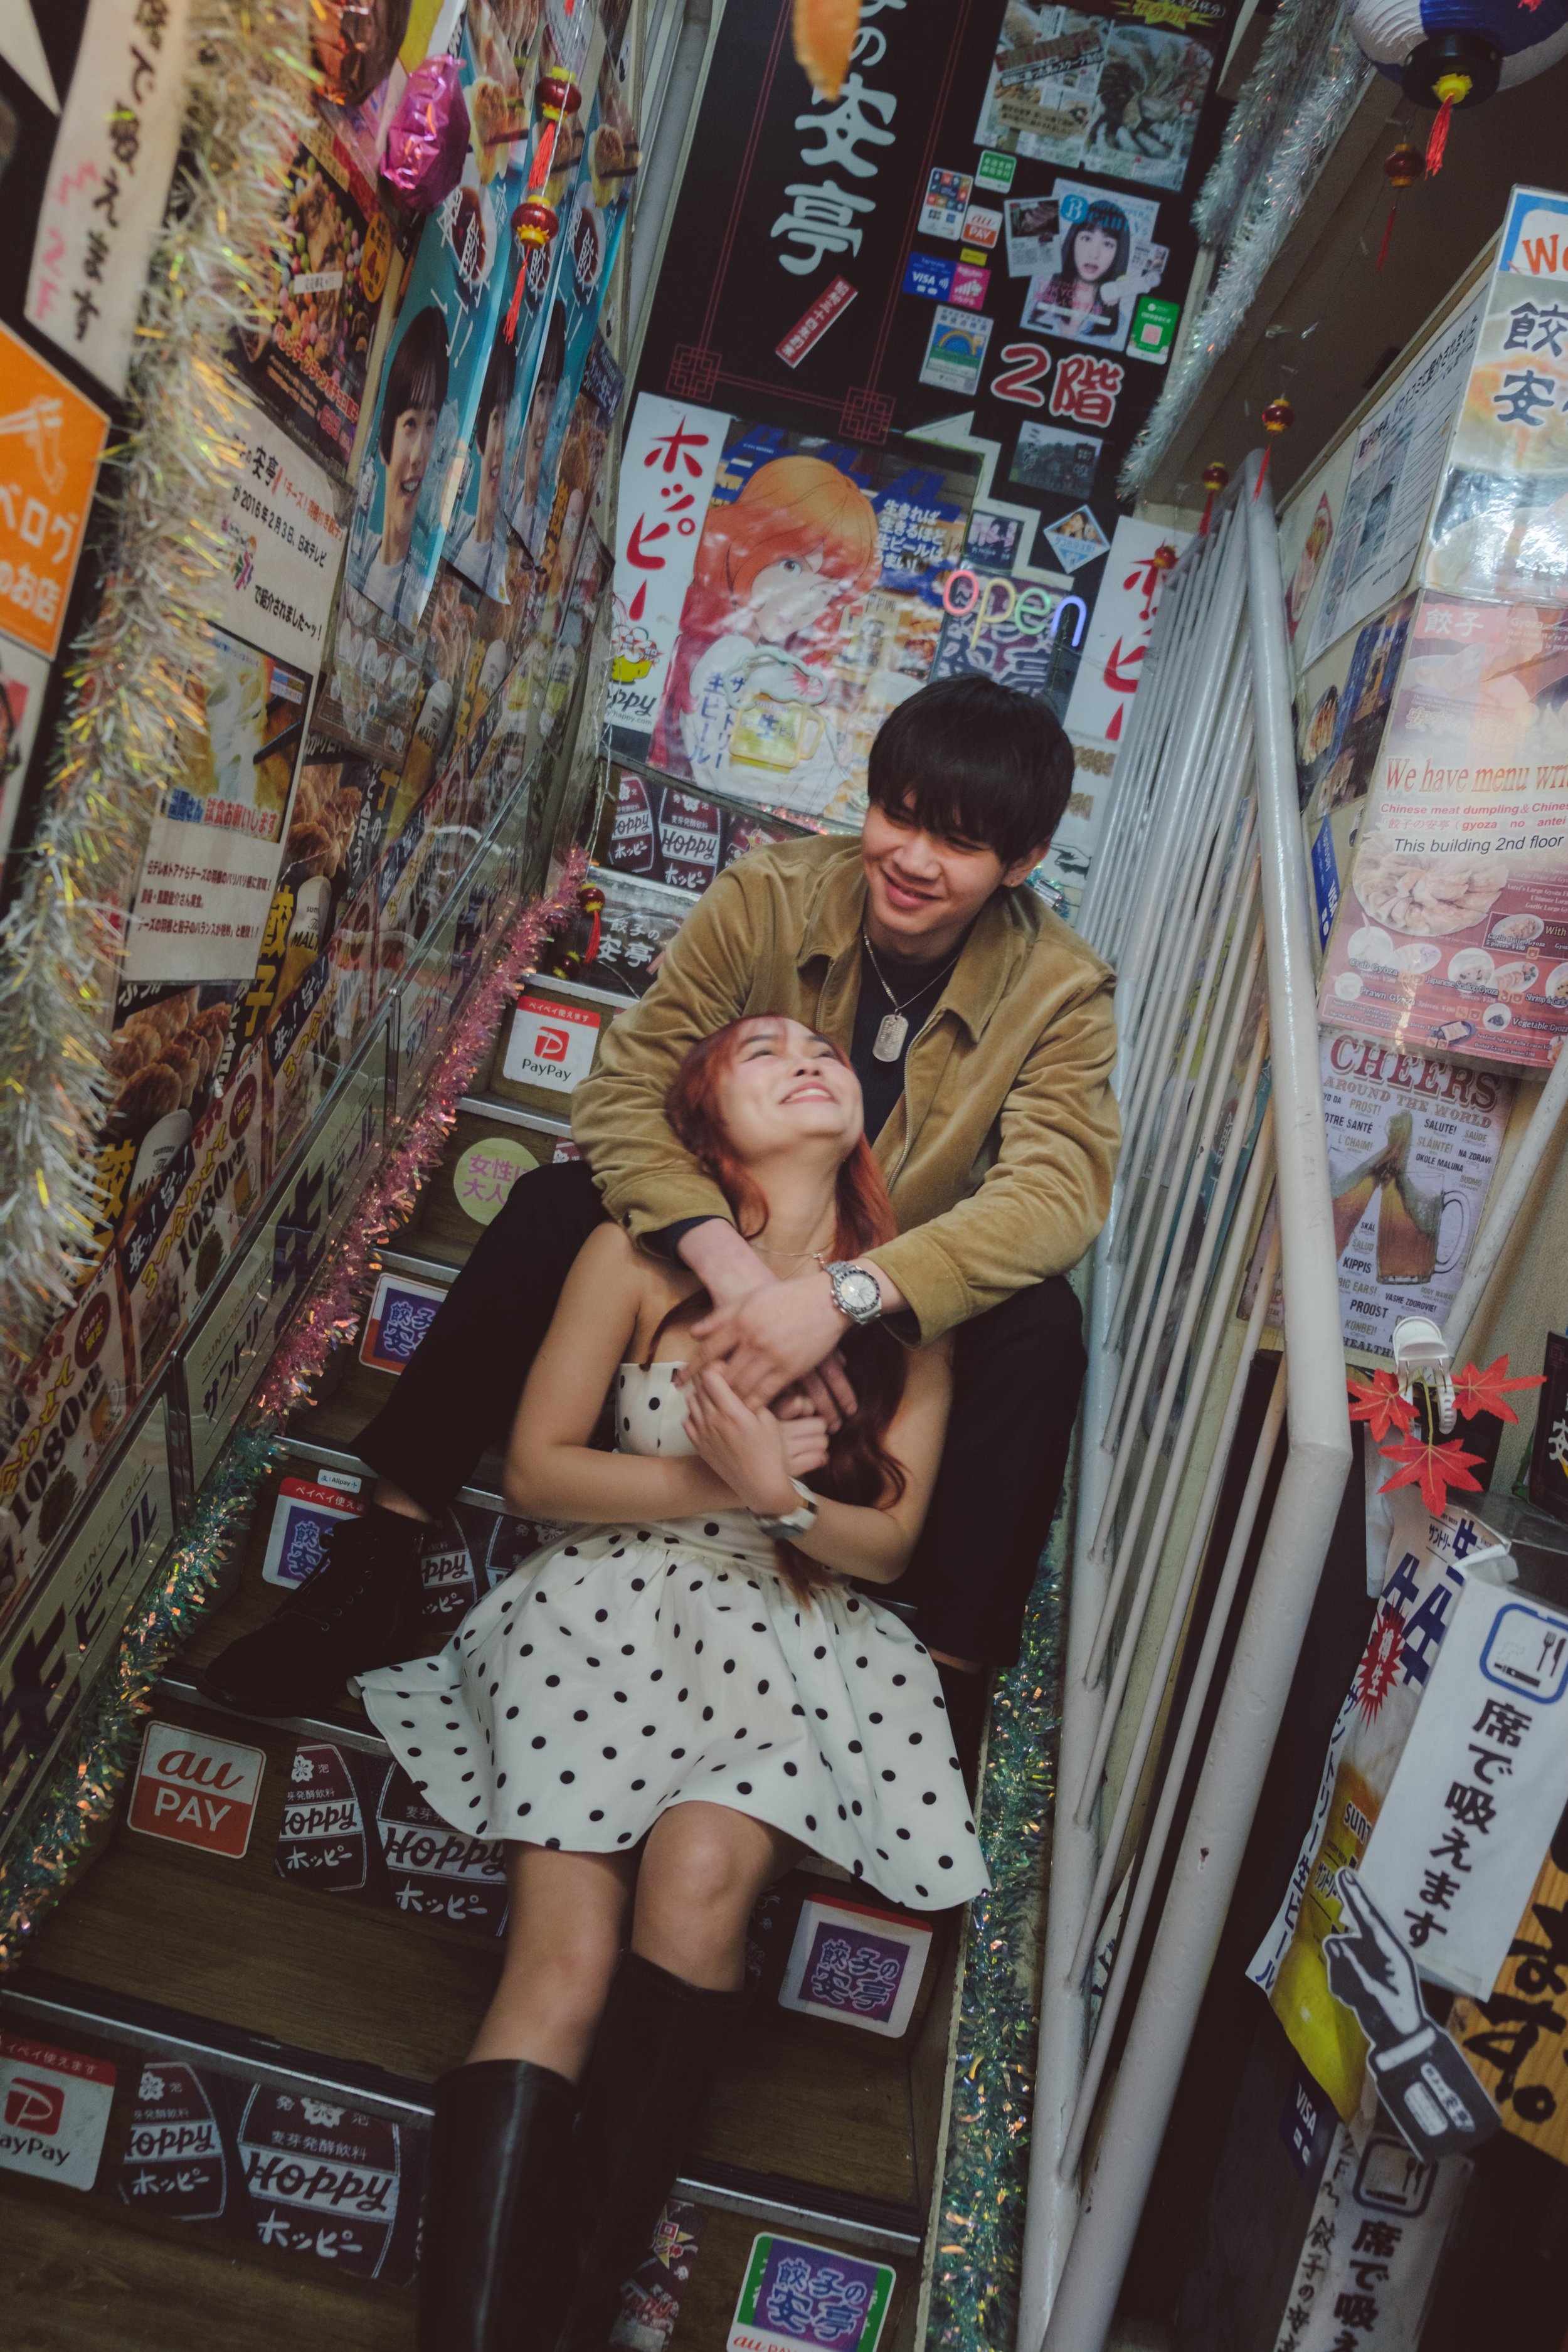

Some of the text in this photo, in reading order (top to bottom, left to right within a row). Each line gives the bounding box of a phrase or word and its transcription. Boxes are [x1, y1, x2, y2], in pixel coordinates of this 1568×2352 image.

[968, 226, 993, 241] PAY
[911, 271, 936, 286] VISA
[991, 342, 1124, 427] 2階
[626, 415, 710, 621] ホッピー
[883, 499, 941, 525] 生きれば
[879, 517, 947, 544] 生きるほど
[876, 534, 943, 566] 生ビールは
[1424, 608, 1485, 638] 餃子
[1510, 617, 1543, 630] Gyoza
[607, 688, 657, 718] ppy
[1386, 758, 1417, 792] We
[1419, 758, 1469, 793] have
[1471, 766, 1528, 792] menu
[1381, 803, 1428, 814] Chinese
[1431, 805, 1460, 815] meat
[1463, 803, 1519, 817] dumpling
[1510, 819, 1525, 828] no
[1537, 816, 1566, 827] antei
[615, 842, 648, 859] ホッピー
[662, 829, 716, 861] Hoppy
[1394, 834, 1565, 854] This building 2nd floor
[665, 867, 707, 889] ホッピー
[1328, 880, 1340, 918] VISA
[610, 919, 660, 940] 餃子の
[1545, 924, 1567, 936] With
[598, 934, 655, 968] 安亭
[1349, 958, 1399, 977] Crab Gyoza
[1360, 987, 1387, 1000] Prawn
[1425, 975, 1500, 997] Japanese Scallop Gyoza
[1526, 993, 1546, 1005] Shrimp
[529, 1001, 590, 1023] ペイペイ使えます
[1513, 1017, 1549, 1031] Vegetable
[521, 1058, 573, 1082] PayPay
[1330, 1034, 1503, 1115] CHEERS
[1324, 1077, 1492, 1129] AROUND THE WORLD
[1349, 1098, 1382, 1116] PROST!
[1346, 1118, 1374, 1134] SANTÉ
[1424, 1118, 1457, 1135] SALUTE!
[1338, 1134, 1374, 1152] L'CHAIM!
[1458, 1149, 1467, 1159] NA
[1416, 1153, 1464, 1173] OKOLE MALUNA
[1459, 1175, 1482, 1188] BUDMO
[1352, 1239, 1374, 1253] SALUD
[1342, 1256, 1372, 1274] KIPPIS
[1352, 1281, 1378, 1296] EARS!
[1350, 1299, 1389, 1319] PROOST
[1385, 1292, 1437, 1313] VASHE ZDOROVIE!
[383, 1323, 428, 1357] 安
[1345, 1319, 1377, 1336] KONBEI!
[1428, 1522, 1451, 1552] サントリー
[73, 1516, 115, 1589] SINCE
[422, 1554, 467, 1583] ppy
[156, 1749, 245, 1790] au
[154, 1787, 232, 1833] PAY
[1404, 1697, 1532, 1949] 席で吸えます
[287, 1845, 352, 1871] ホッピー
[383, 1826, 507, 1875] Hoppy
[395, 1879, 488, 1920] ホッピー
[820, 1939, 901, 1981] 餃子の
[811, 1968, 896, 2011] 安亭
[1298, 2082, 1317, 2136] VISA
[270, 2131, 368, 2161] 麦芽発酵飲料
[131, 2168, 211, 2195] ホッピー
[245, 2150, 394, 2212] Hoppy
[257, 2208, 363, 2257] ホッピー
[777, 2258, 868, 2304] 餃子の
[766, 2284, 864, 2341] 安亭
